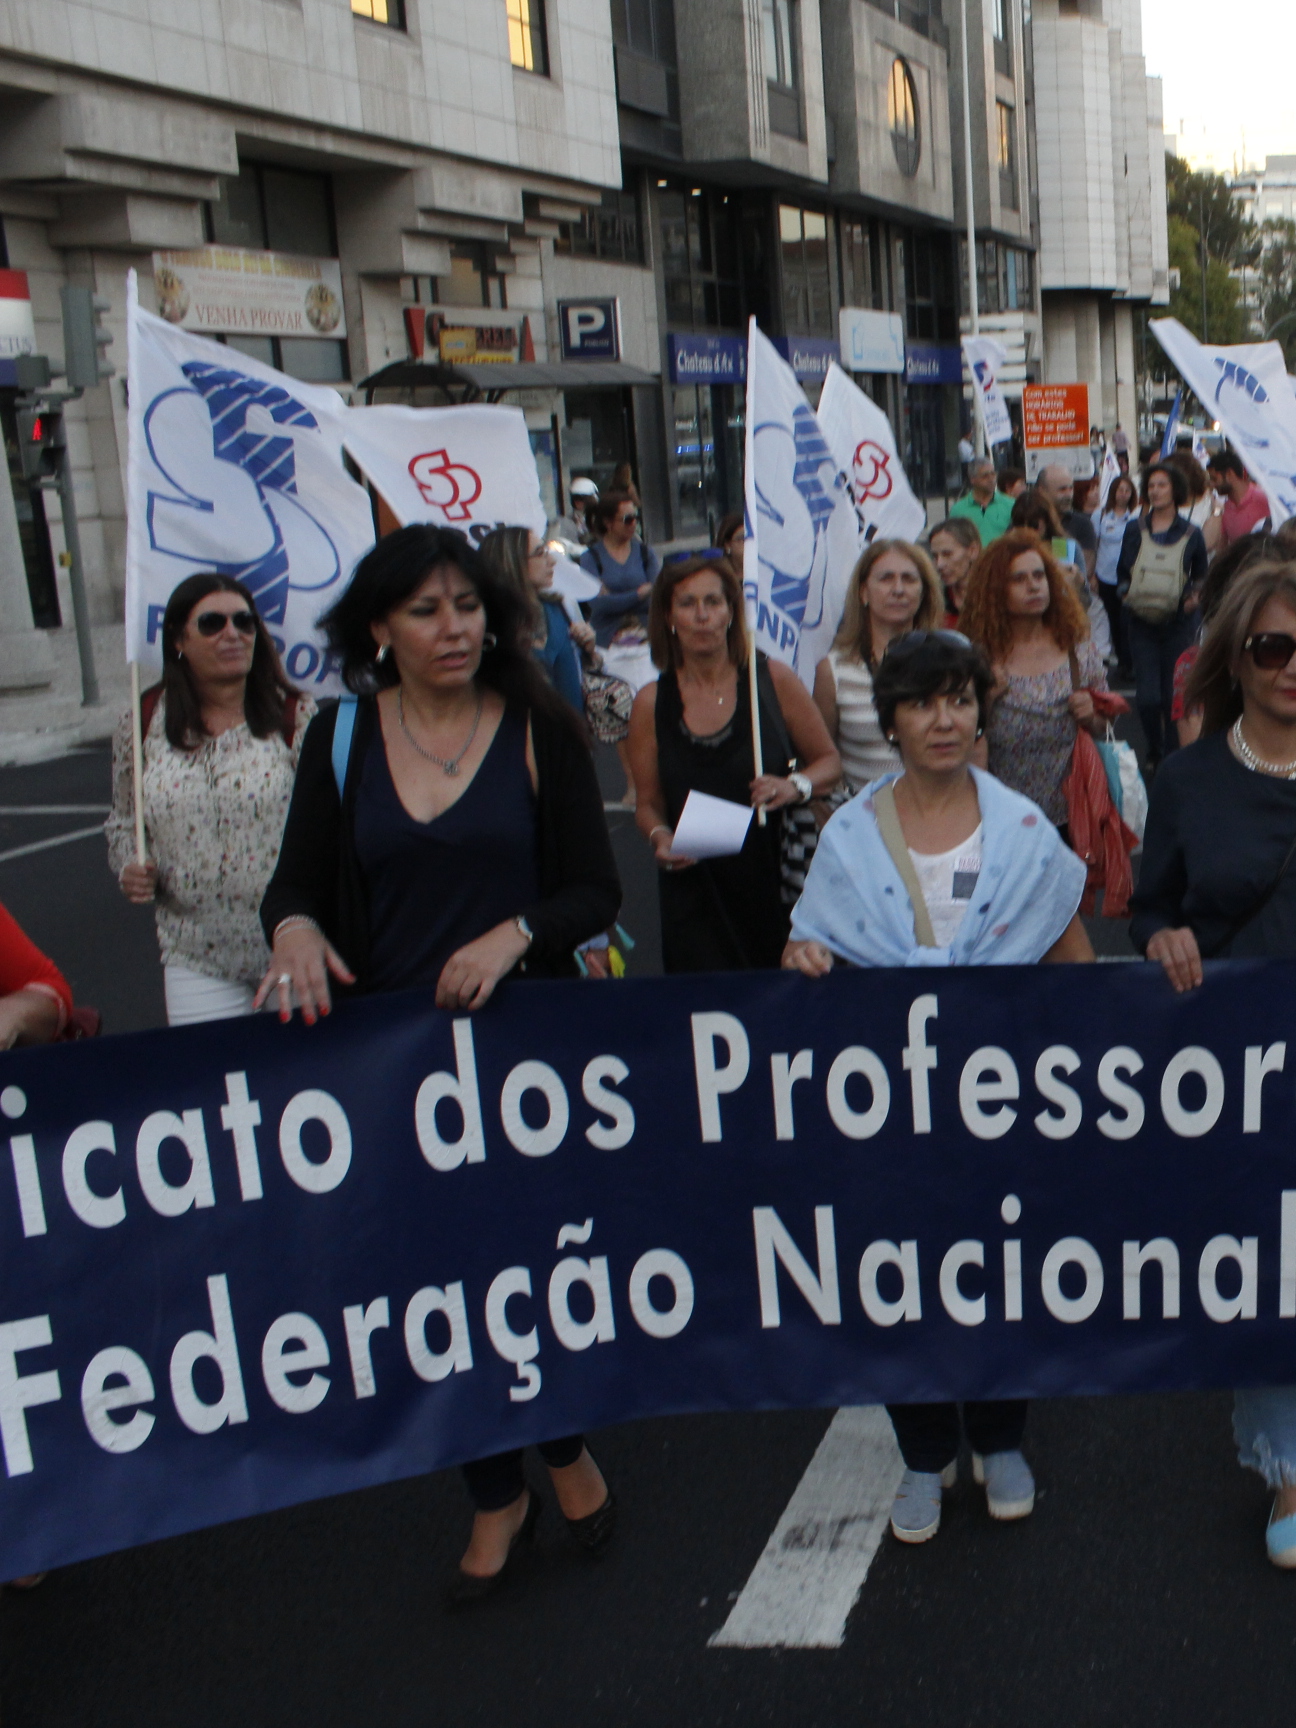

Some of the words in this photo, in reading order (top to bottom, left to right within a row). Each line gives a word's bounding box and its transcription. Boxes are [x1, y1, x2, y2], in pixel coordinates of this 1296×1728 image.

[195, 304, 248, 327] VENHA
[251, 307, 303, 330] PROVAR
[568, 306, 606, 349] P
[0, 1070, 352, 1238] icato
[415, 1018, 635, 1172] dos
[0, 1218, 695, 1479] Federação
